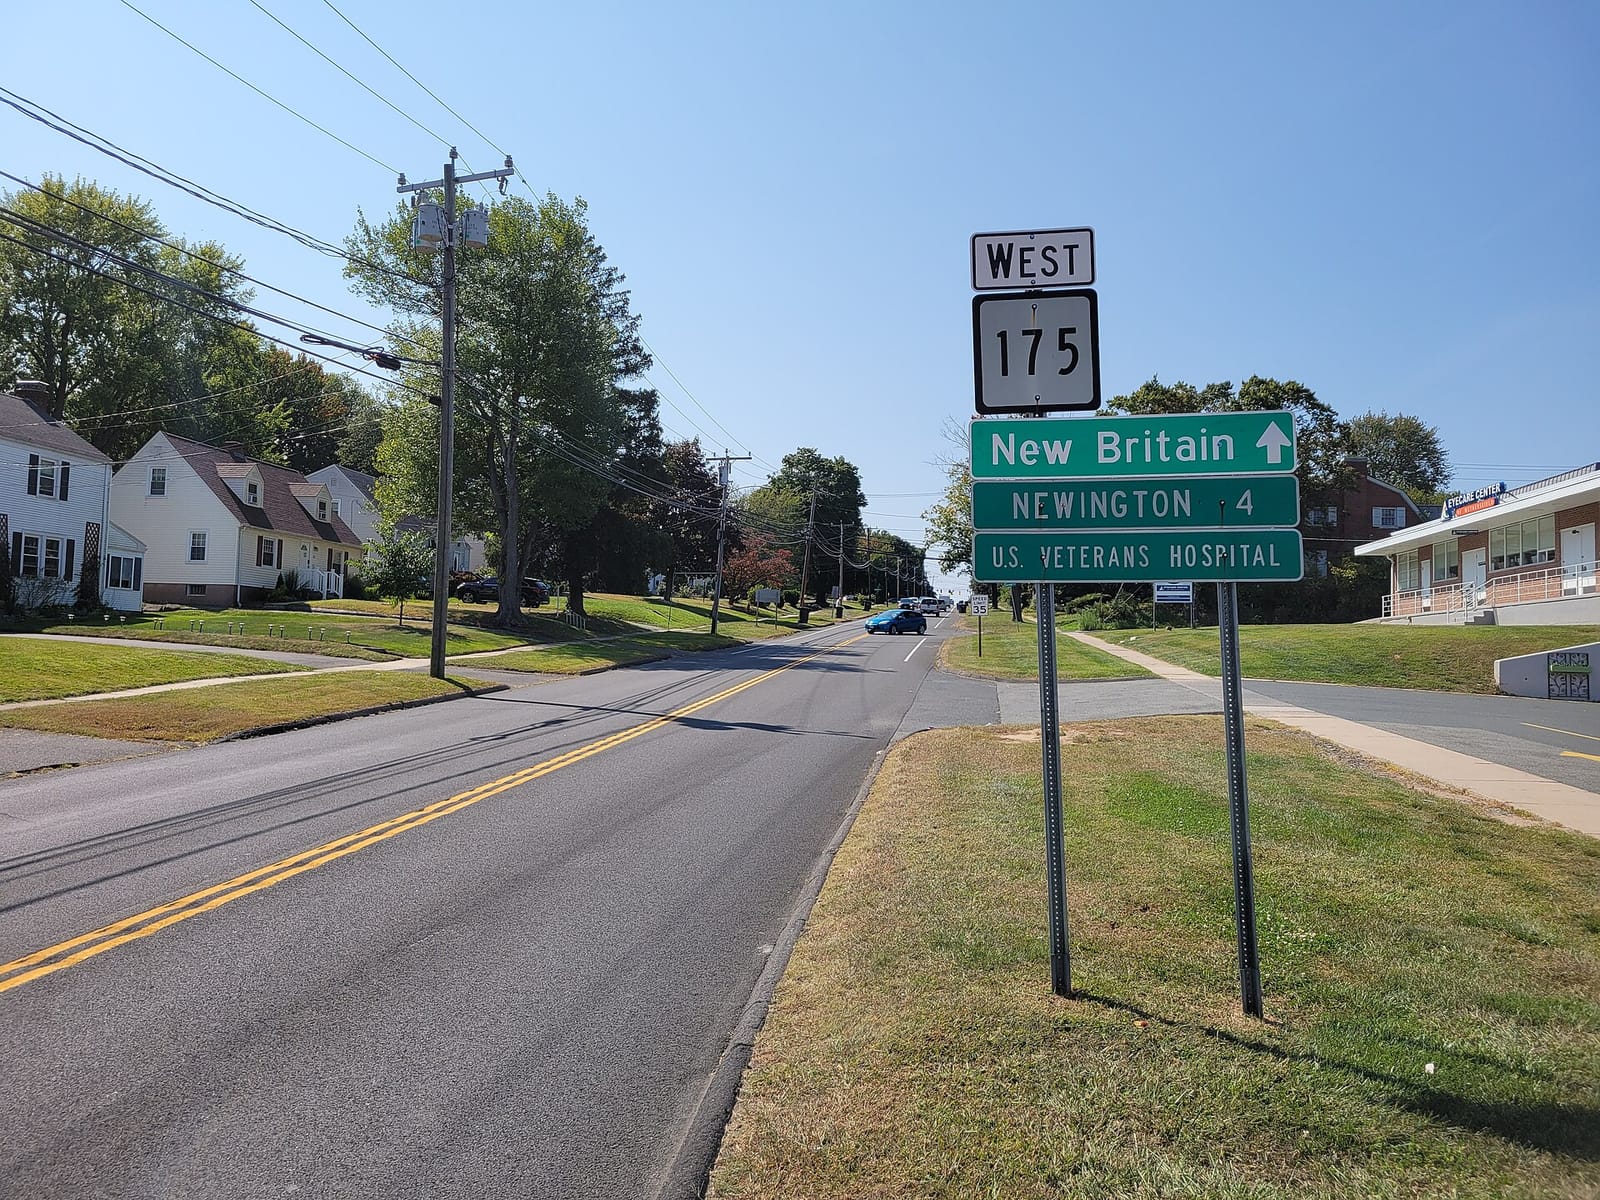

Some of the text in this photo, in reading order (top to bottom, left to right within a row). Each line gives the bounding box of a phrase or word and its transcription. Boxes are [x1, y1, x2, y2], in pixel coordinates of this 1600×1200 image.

[986, 242, 1080, 280] WEST
[996, 327, 1079, 377] 175
[991, 428, 1234, 466] New Britain
[1012, 489, 1253, 520] NEWINGTON 4
[1448, 483, 1501, 508] EYECARE CENTER
[992, 543, 1281, 569] U.S. VETERANS HOSPITAL
[973, 605, 986, 614] 35
